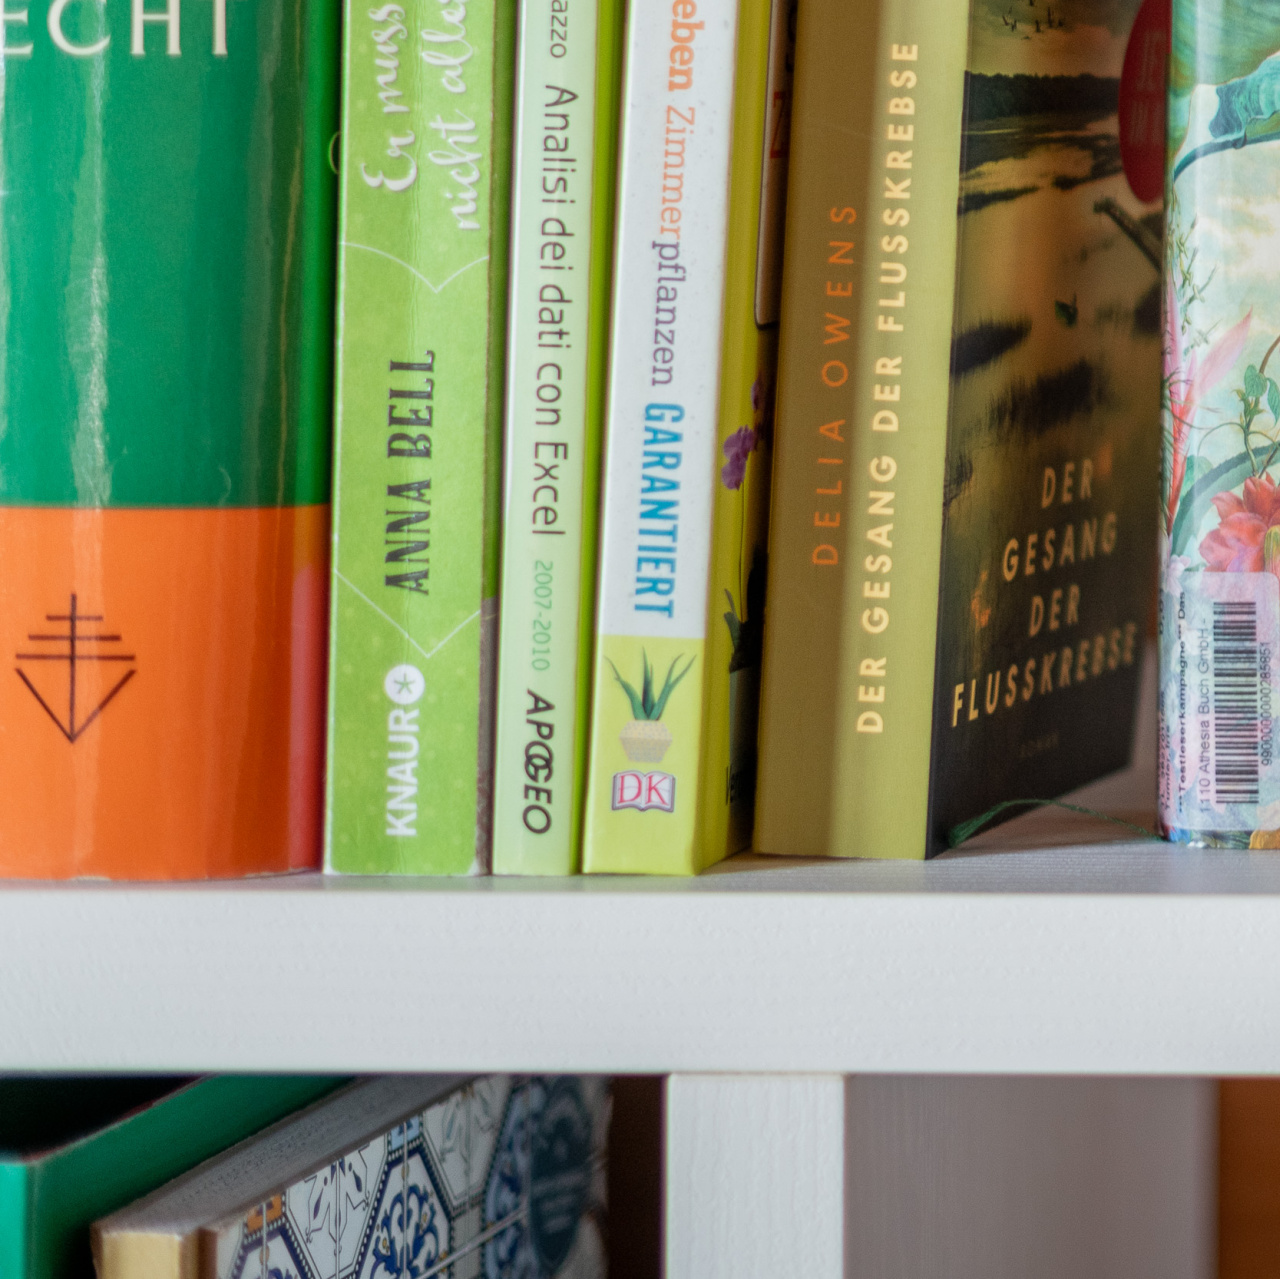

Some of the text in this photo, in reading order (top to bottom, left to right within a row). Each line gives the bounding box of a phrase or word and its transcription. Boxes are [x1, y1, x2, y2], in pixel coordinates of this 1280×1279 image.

[368, 3, 410, 114] muss
[360, 129, 417, 193] Er
[427, 108, 482, 230] nicht
[541, 84, 580, 204] Analisi
[539, 218, 575, 271] dei
[651, 104, 696, 387] Zimmerpflanzen
[537, 284, 573, 350] dati
[534, 361, 563, 427] con
[812, 205, 857, 567] DELIA OWENS
[857, 43, 919, 734] DER GESANG DER FLUSSKREBSE
[384, 348, 436, 597] ANNA BELL
[531, 441, 569, 536] Excel
[1041, 458, 1094, 509] DER
[633, 402, 686, 619] GARANTIERT
[1002, 512, 1117, 582] GESANG
[531, 559, 554, 672] 2007-2010
[1028, 584, 1081, 638] DER
[1177, 591, 1186, 620] Das
[952, 623, 1138, 728] FLUSSKREBSE
[1196, 630, 1209, 675] GmbH
[1197, 677, 1210, 715] Buch
[386, 706, 420, 838] KNAUR
[1199, 719, 1211, 774] Athesia
[617, 773, 670, 807] DK
[1200, 778, 1212, 814] 1110
